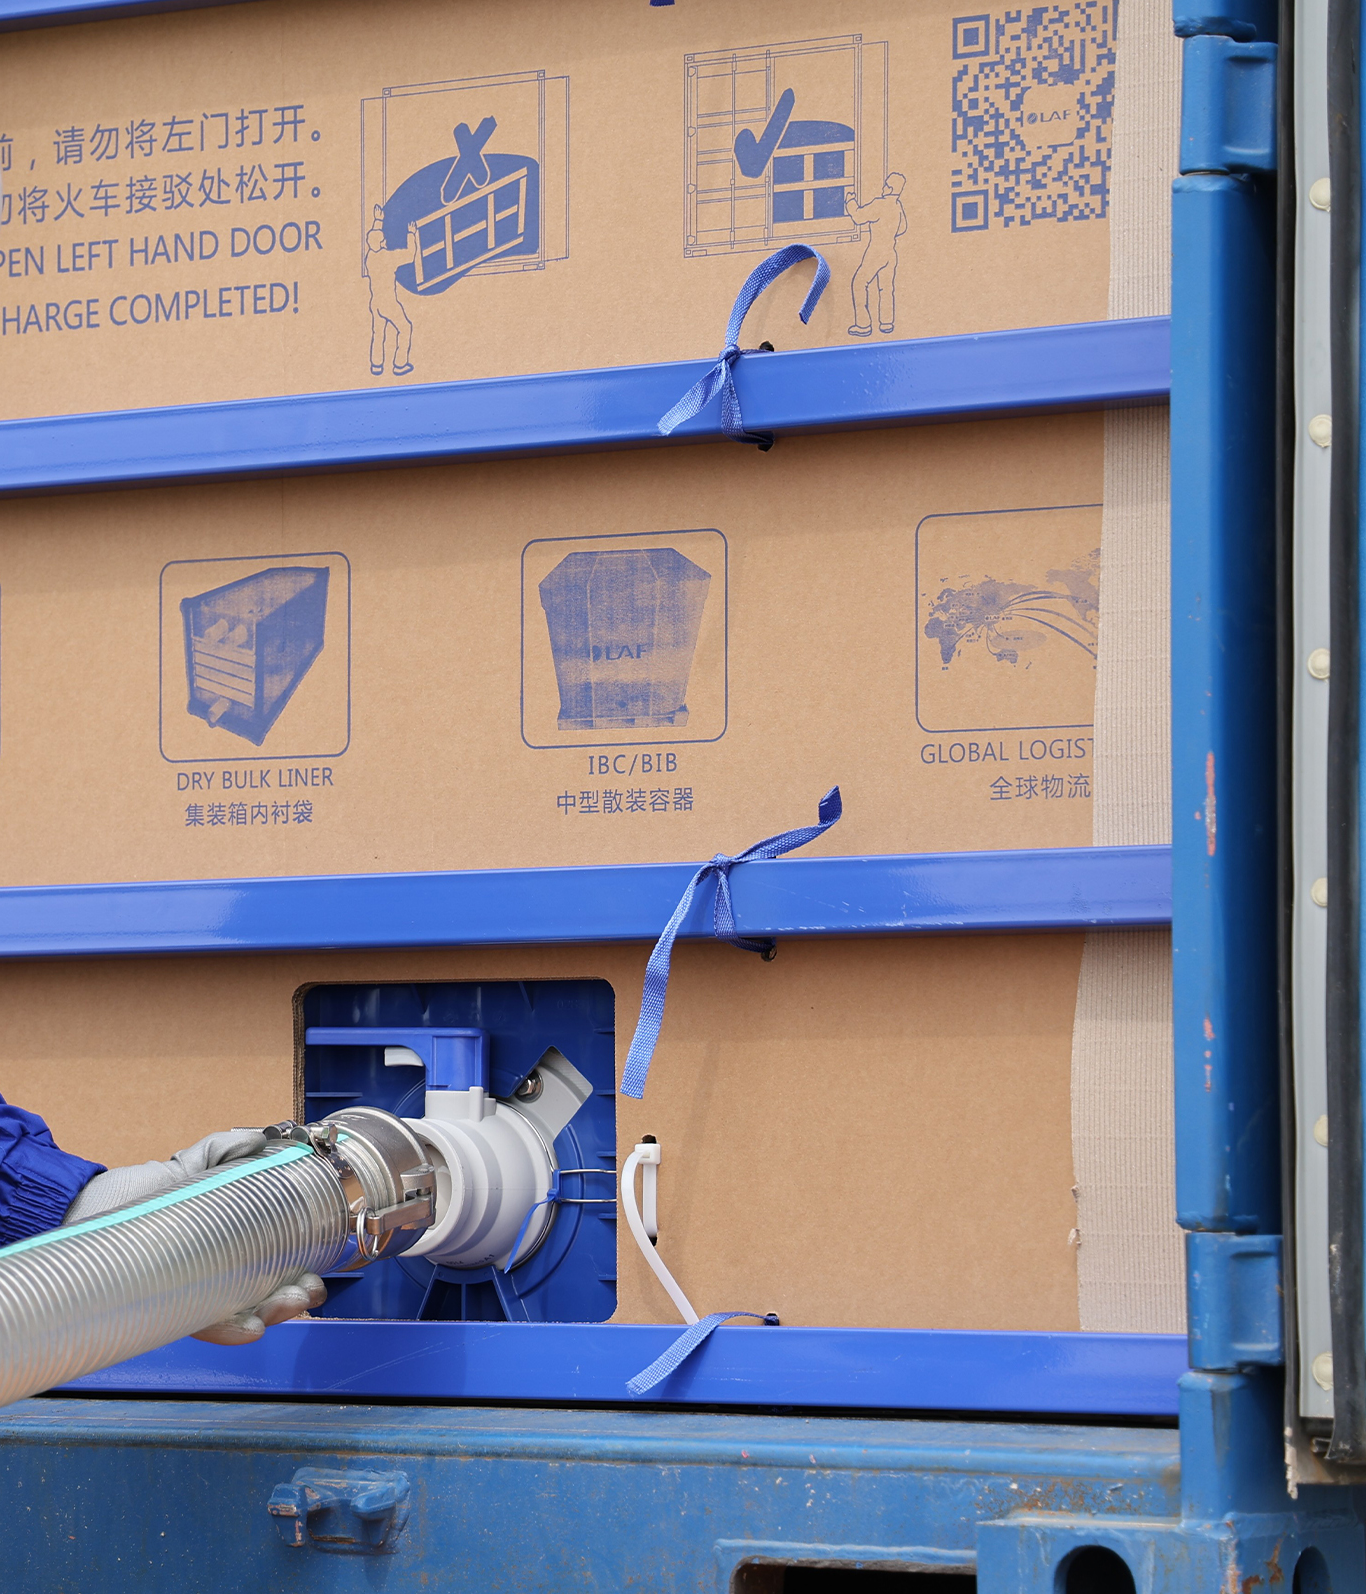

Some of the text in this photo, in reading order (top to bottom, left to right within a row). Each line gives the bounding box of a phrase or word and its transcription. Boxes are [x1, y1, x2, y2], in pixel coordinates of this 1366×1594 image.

[1040, 109, 1071, 122] LAF
[57, 240, 119, 273] LEFT
[129, 230, 219, 267] HAND
[230, 220, 323, 257] DOOR
[109, 281, 300, 328] COMPLETED!
[588, 752, 678, 777] IBC/BIB
[920, 741, 1010, 764] GLOBAL
[177, 767, 334, 792] DRY BULK LINER
[990, 772, 1091, 801] 全球物流
[185, 800, 314, 828] 集装箱内衬袋
[556, 787, 694, 816] 中型散装容器
